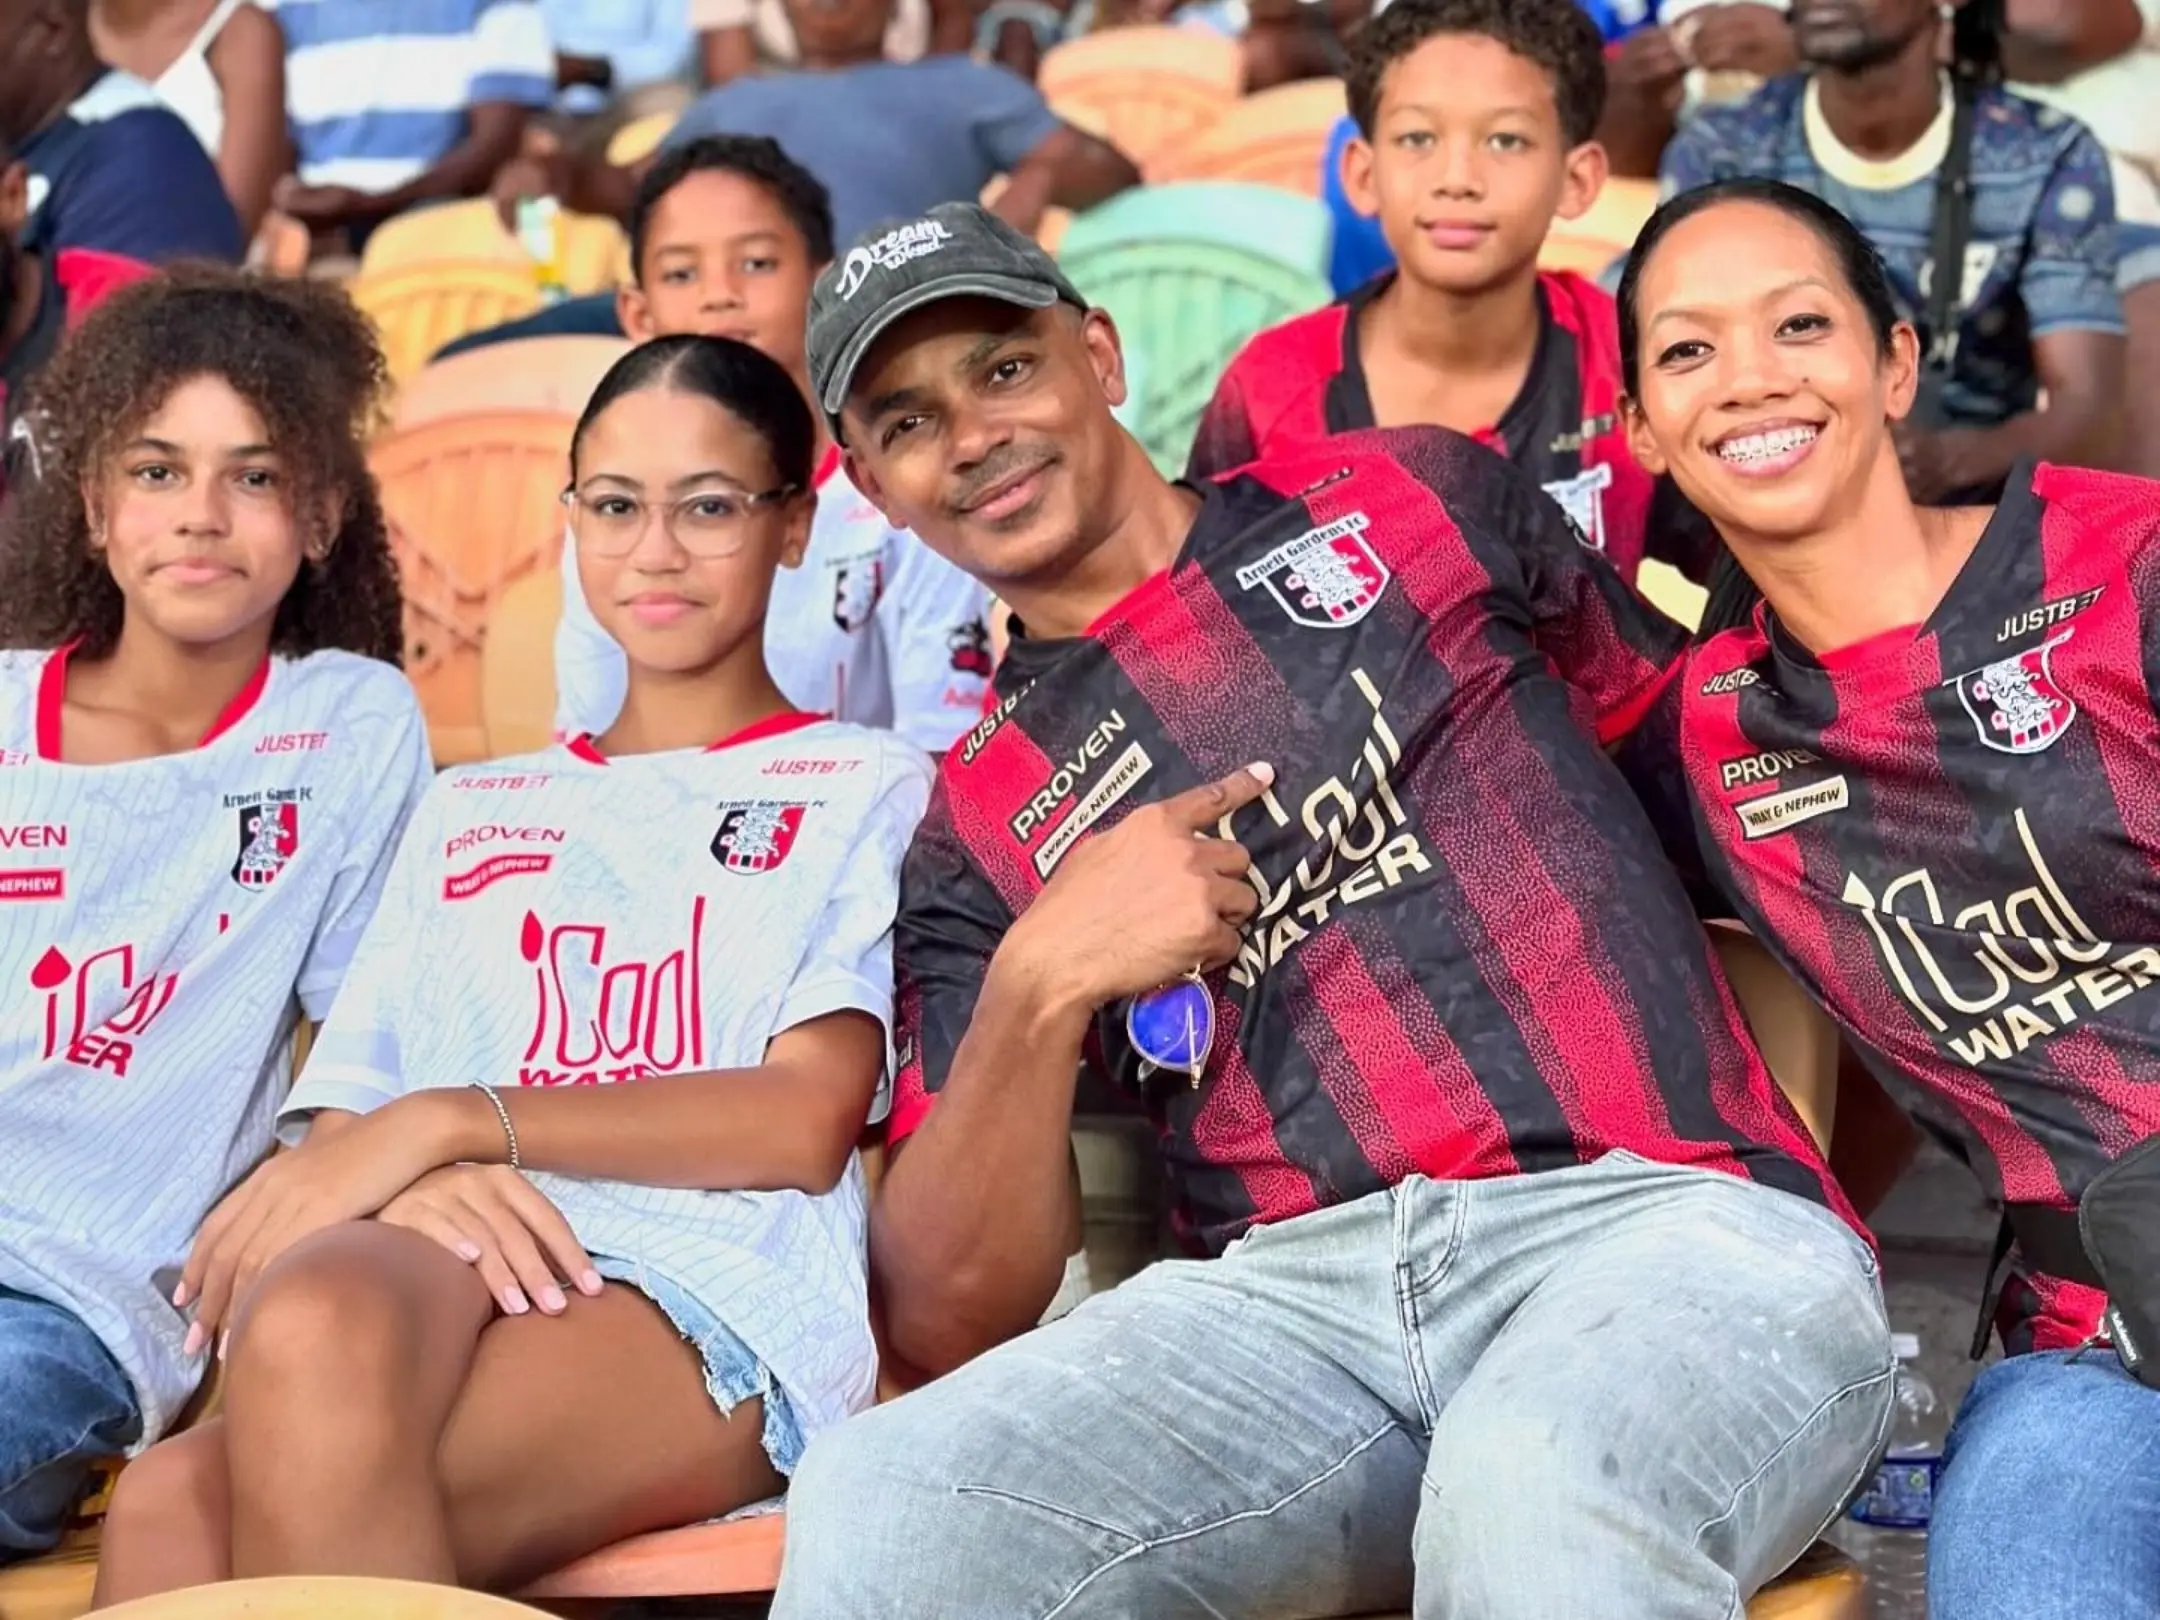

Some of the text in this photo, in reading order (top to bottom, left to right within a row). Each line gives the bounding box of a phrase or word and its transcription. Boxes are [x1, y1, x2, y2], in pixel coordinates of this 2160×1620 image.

[835, 219, 953, 301] Dream
[1287, 523, 1345, 557] Gardens
[1345, 514, 1365, 531] FC
[963, 678, 1036, 762] JUSTB
[1703, 668, 1779, 696] JUSTB
[1012, 708, 1126, 840] PROVEN
[1043, 823, 1076, 861] WRAY
[1090, 755, 1139, 813] NEPHEW
[1194, 668, 1407, 935] Cool
[1722, 748, 1822, 788] PROVE
[1785, 786, 1840, 814] NEPHEW
[446, 825, 565, 859] PROVEN
[1228, 832, 1432, 989] WATER
[1842, 807, 2112, 1032] iCool
[520, 896, 706, 1070] iCool
[1948, 947, 2160, 1067] WATER
